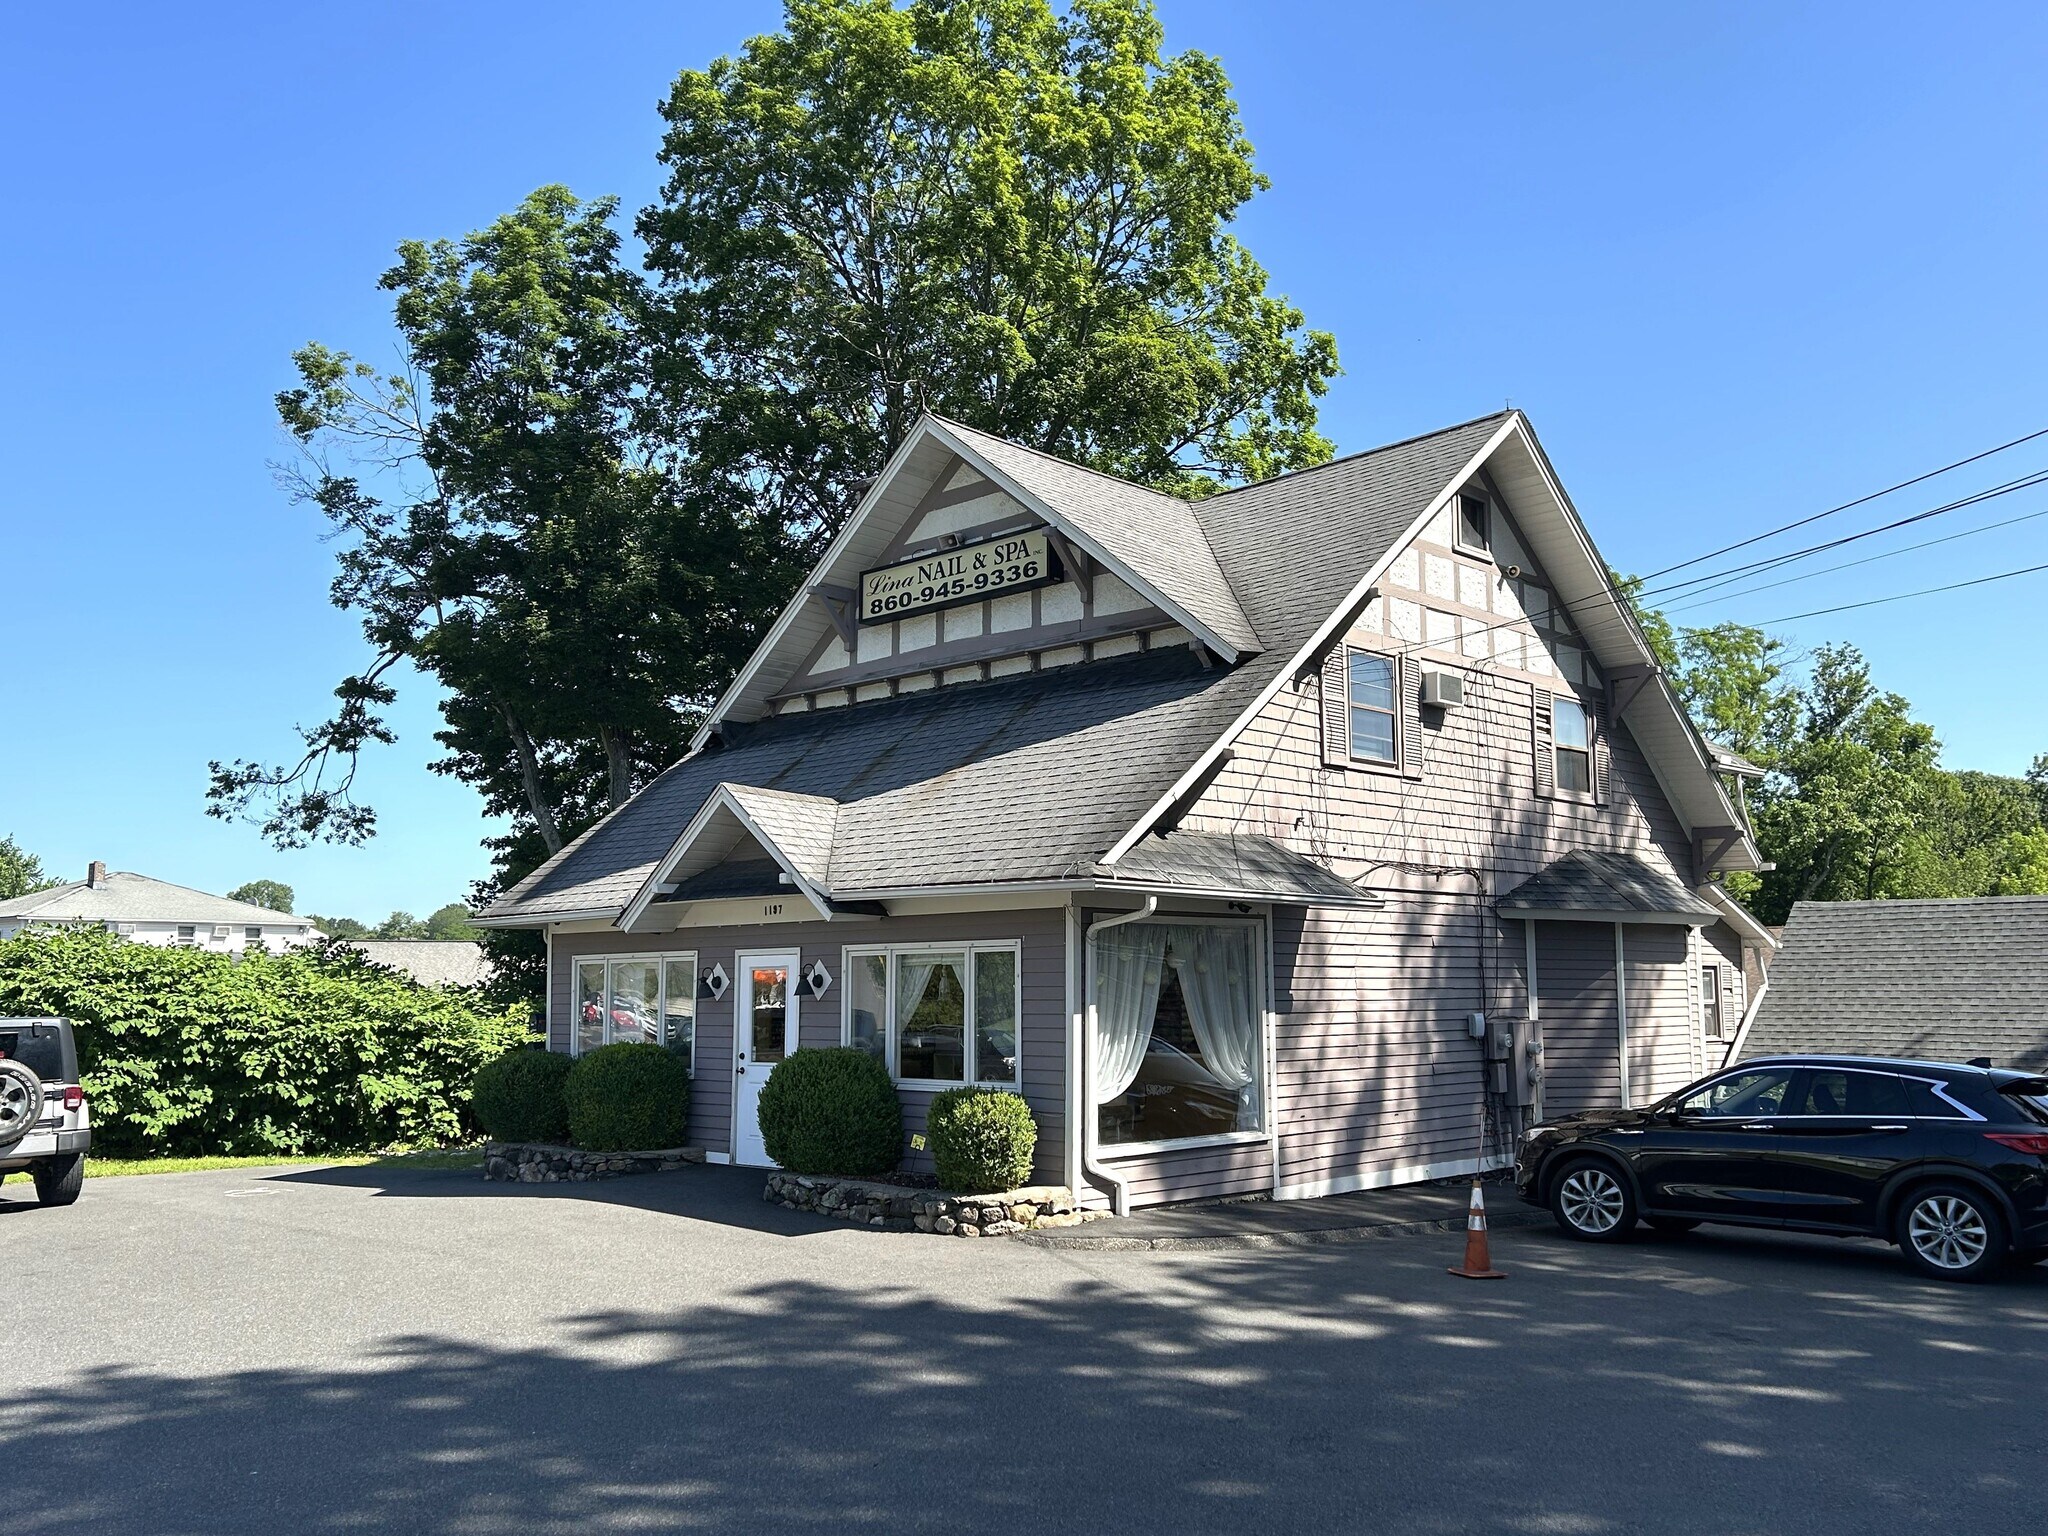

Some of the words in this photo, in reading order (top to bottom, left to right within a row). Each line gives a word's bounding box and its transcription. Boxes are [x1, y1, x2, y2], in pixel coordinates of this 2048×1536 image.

[866, 574, 914, 596] Lina
[917, 555, 967, 584] NAIL
[973, 552, 987, 570] &
[994, 539, 1031, 566] SPA
[870, 560, 1039, 615] 860-945-9336
